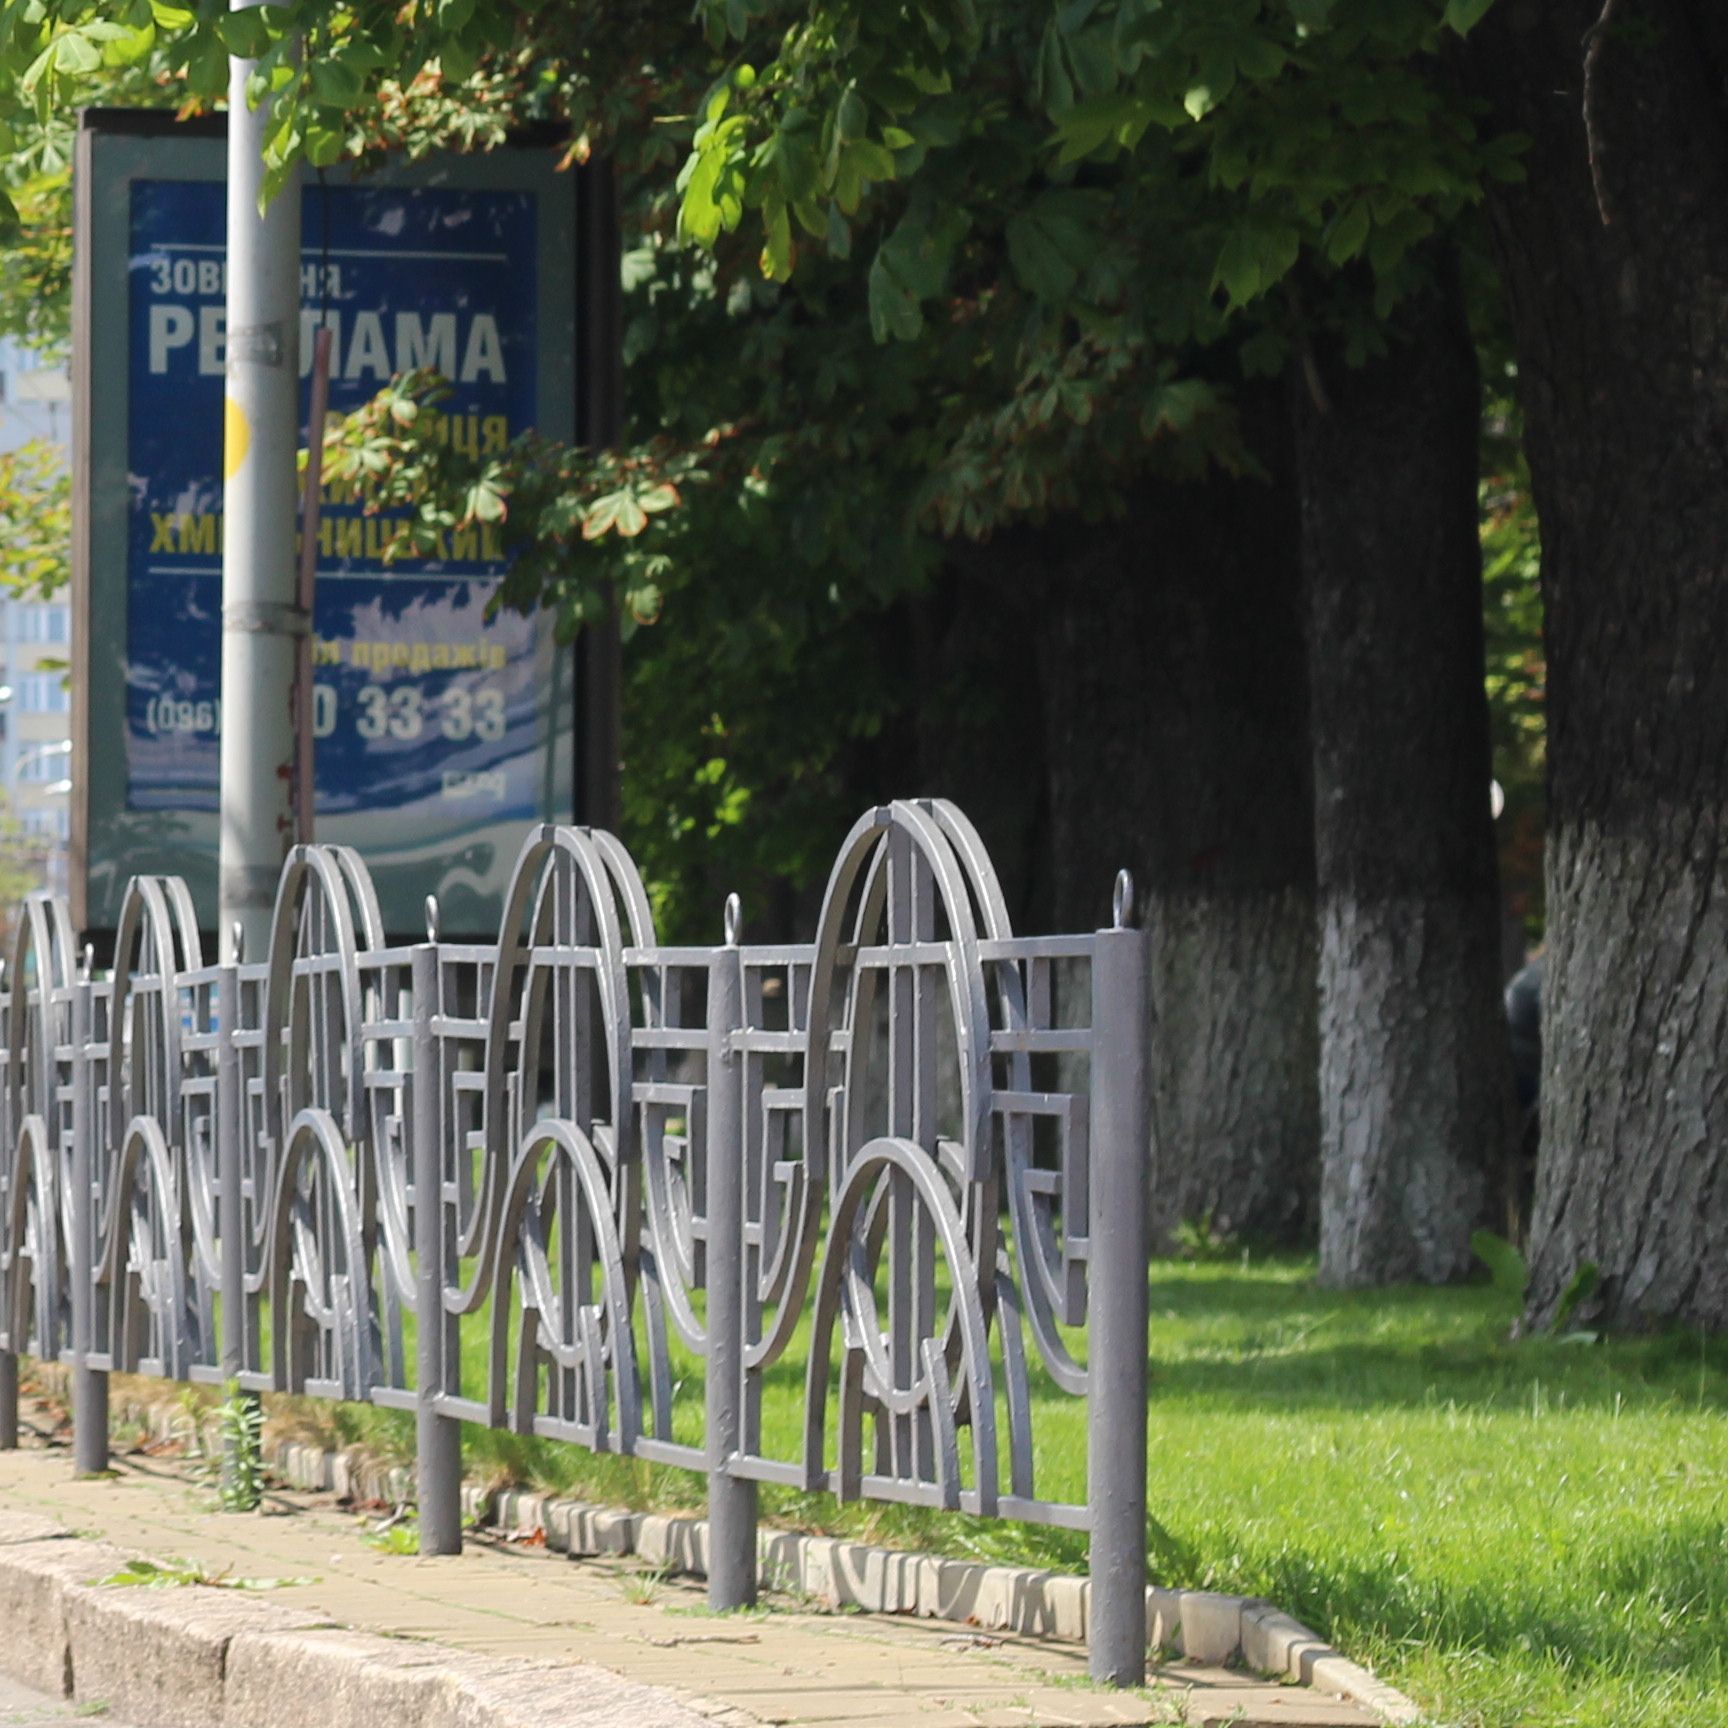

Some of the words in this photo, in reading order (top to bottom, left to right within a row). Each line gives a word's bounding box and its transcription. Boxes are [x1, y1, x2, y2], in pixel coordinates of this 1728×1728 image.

[150, 258, 342, 300] ЗОВНЯ
[149, 303, 507, 384] РЕЛАМА
[356, 684, 424, 742] 33
[440, 685, 507, 743] 33
